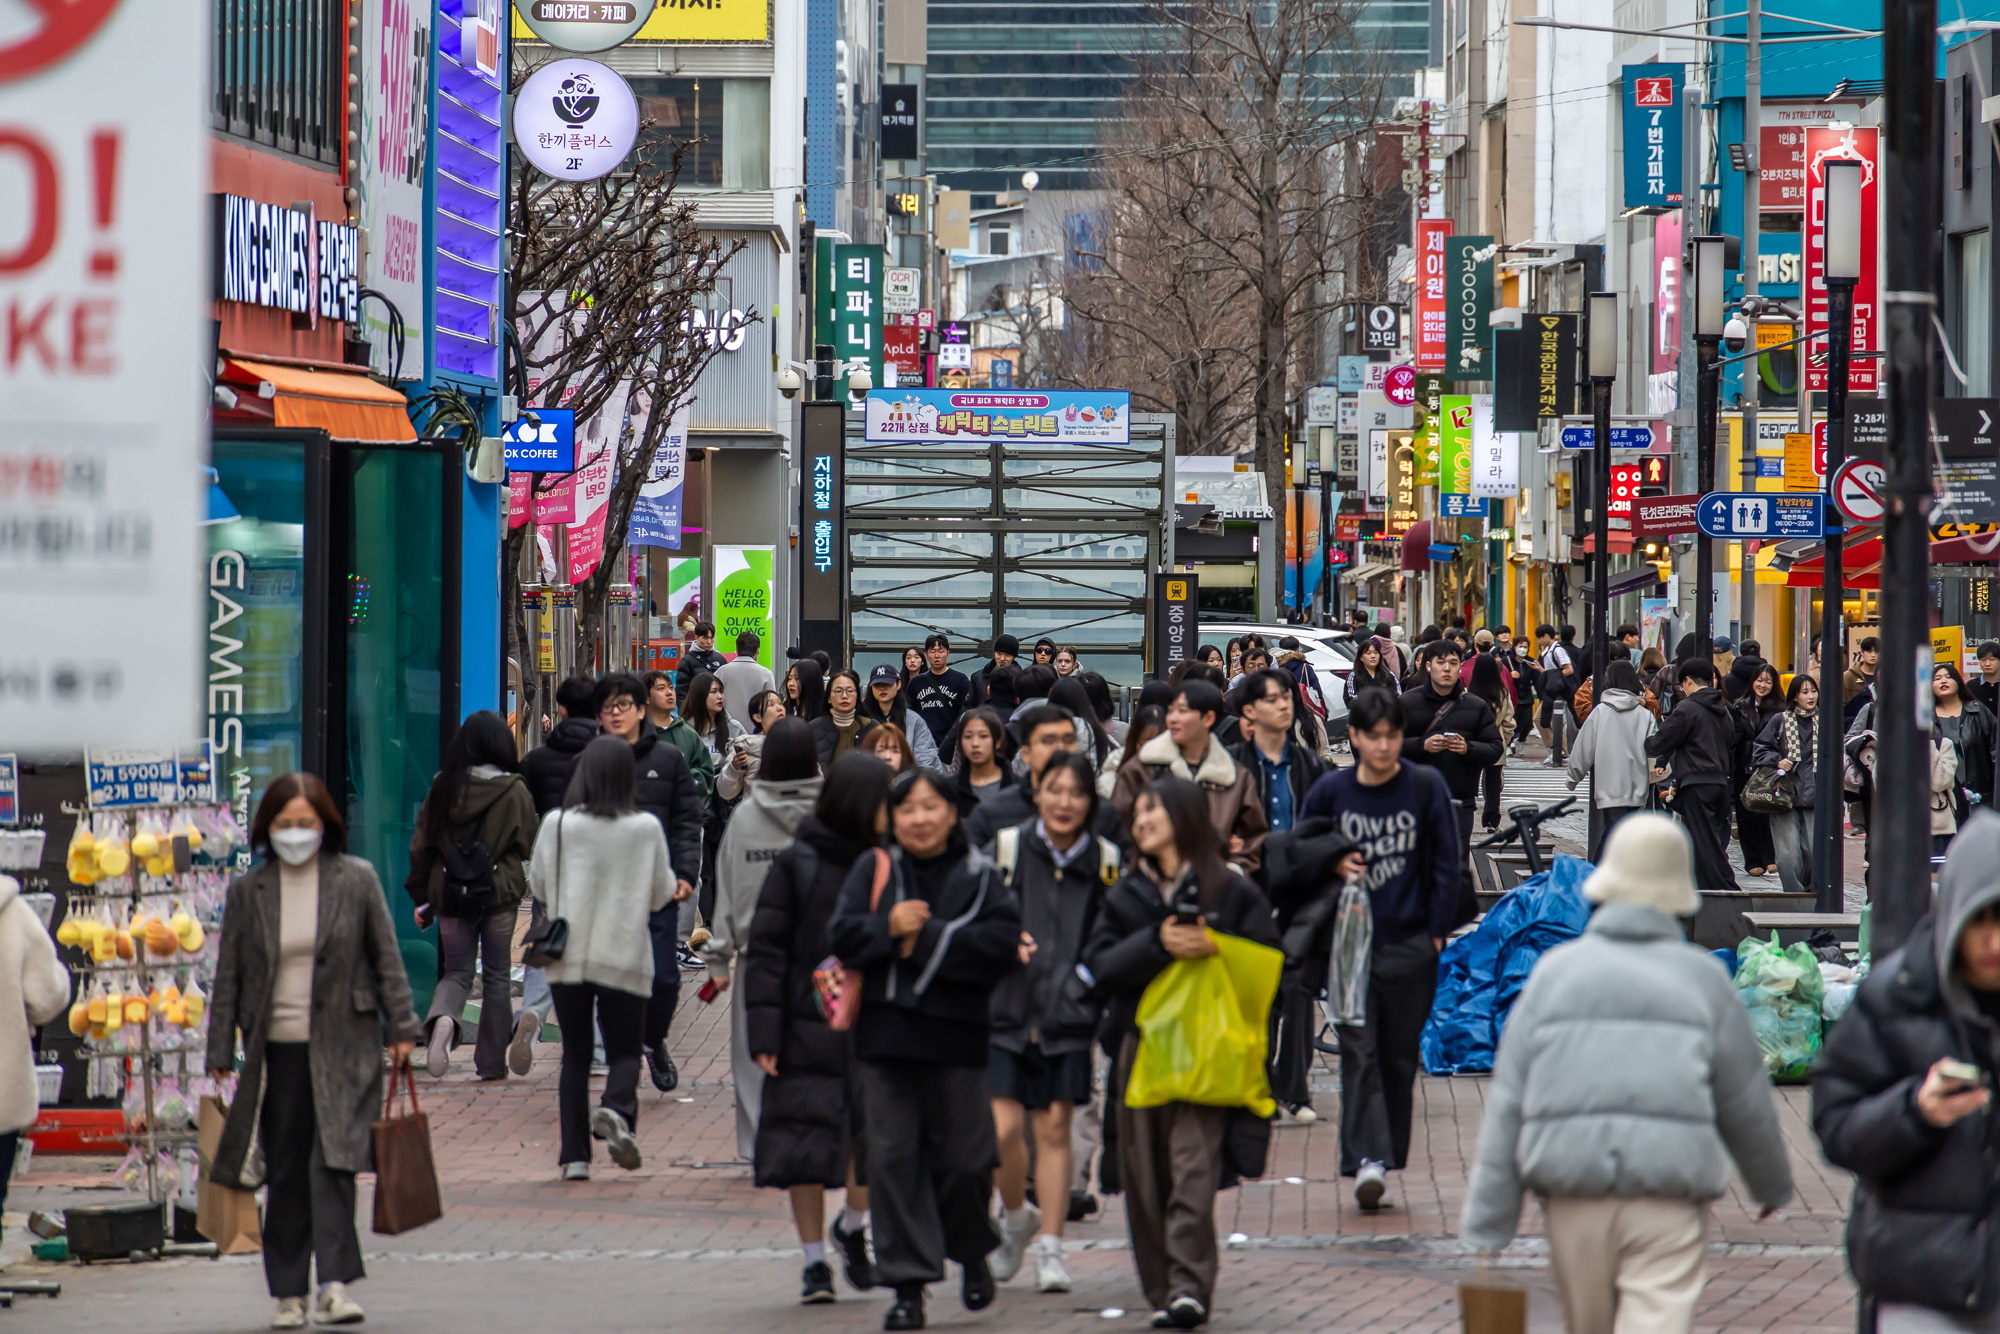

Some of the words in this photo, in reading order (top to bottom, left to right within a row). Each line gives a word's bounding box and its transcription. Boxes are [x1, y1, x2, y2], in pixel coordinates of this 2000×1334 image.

[541, 3, 590, 20] 베이커리
[601, 5, 627, 21] 카페
[1792, 110, 1816, 119] STREET
[1817, 110, 1835, 119] PIZZA
[538, 132, 613, 150] 한끼플러스
[1778, 133, 1797, 145] 1인용
[1647, 109, 1666, 195] 7번가피자
[566, 158, 583, 170] 2F
[224, 193, 257, 304] KING
[259, 203, 307, 313] GAMES
[1426, 231, 1444, 299] 제이원
[1462, 245, 1477, 350] CROCODIL
[1538, 331, 1559, 416] 한국공인금거래소
[994, 397, 1016, 405] 캐릭터
[1018, 397, 1040, 406] 상점가
[938, 411, 989, 433] 캐릭터
[992, 414, 1059, 433] 스트리트
[1854, 413, 1886, 424] 2·28기
[881, 422, 905, 433] 22개
[908, 422, 929, 434] 상점
[1564, 434, 1577, 442] 591
[1635, 434, 1649, 442] 595
[520, 449, 558, 458] COFFEE
[813, 456, 832, 509] 지하철
[1399, 461, 1413, 505] 럭셔리
[1776, 498, 1814, 507] 개방화장실
[814, 520, 832, 573] 출입구
[724, 588, 764, 598] HELLO
[722, 599, 741, 608] WE
[743, 599, 766, 608] ARE
[726, 616, 761, 626] OLIVE
[209, 550, 244, 758] GAMES
[91, 768, 114, 784] 1개
[118, 762, 173, 780] 5900원
[103, 784, 129, 800] 2개
